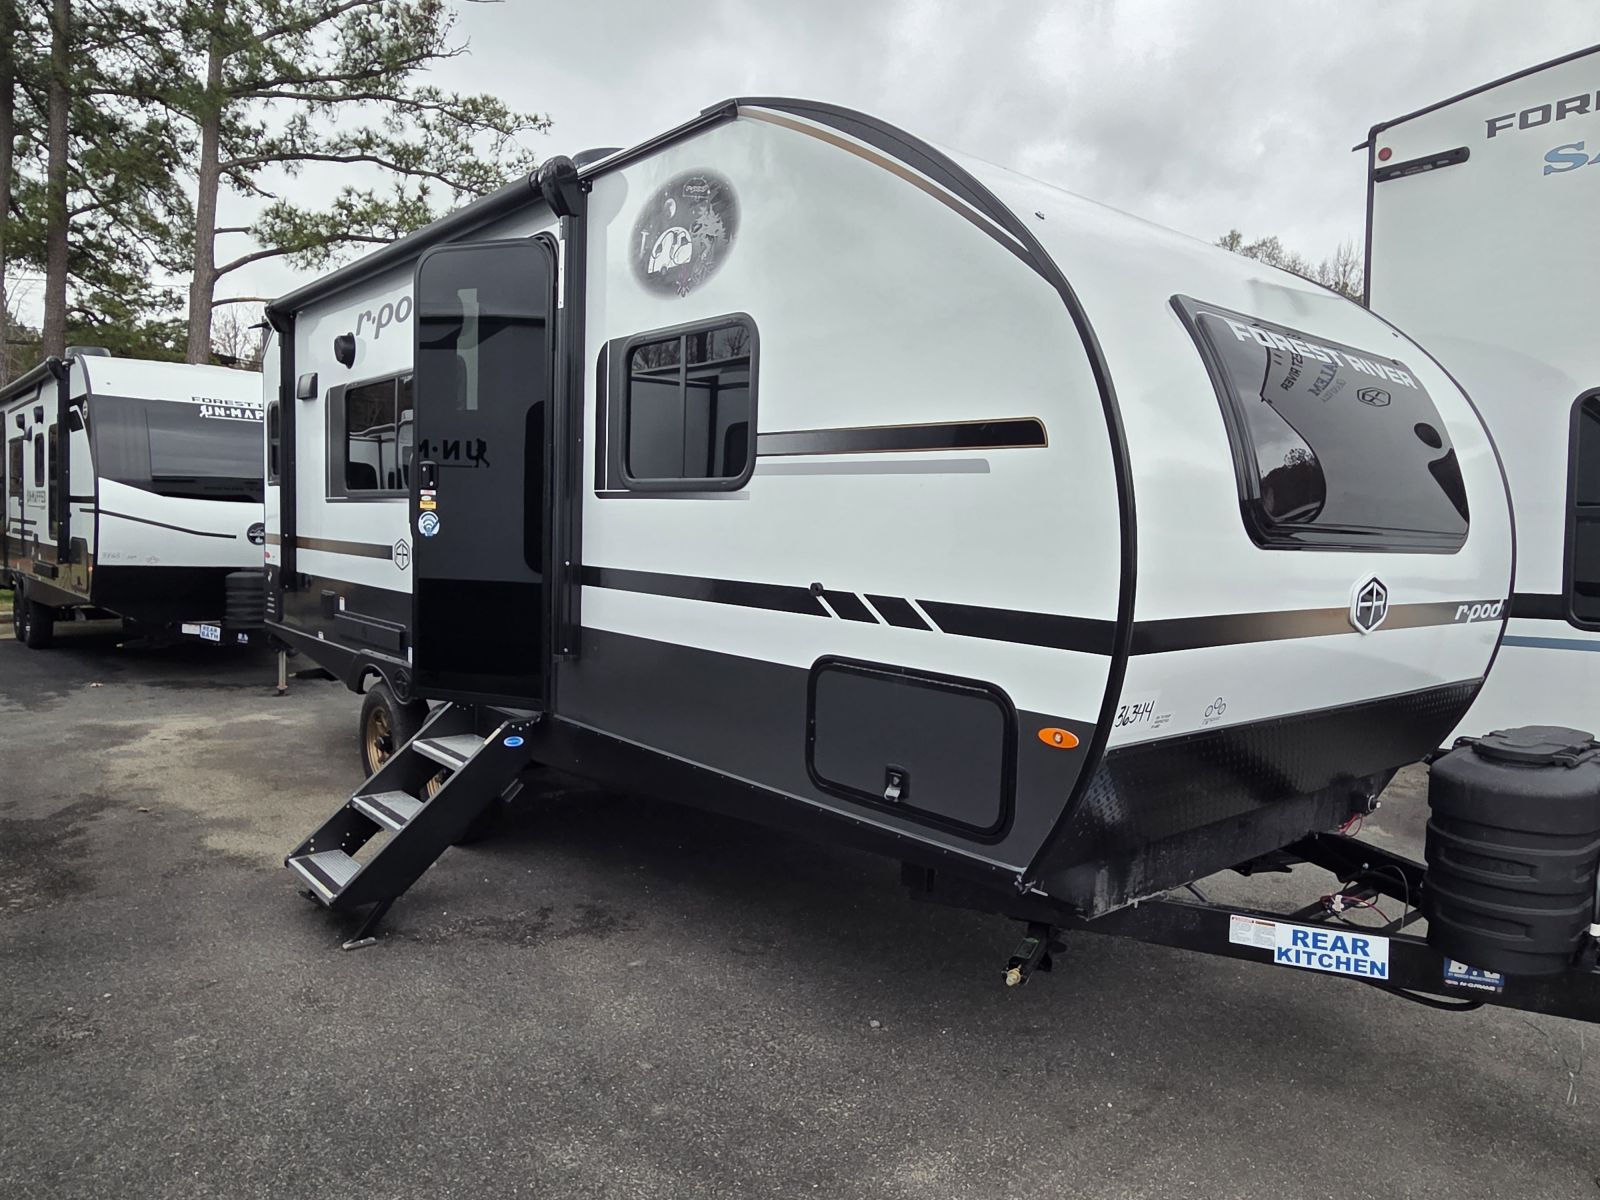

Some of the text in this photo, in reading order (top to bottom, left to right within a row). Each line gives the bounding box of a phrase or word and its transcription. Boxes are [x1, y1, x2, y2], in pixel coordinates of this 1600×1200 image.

[1485, 91, 1600, 138] FOR
[1224, 318, 1418, 390] FOREST RIVER
[1115, 700, 1155, 727] 36344
[1292, 929, 1370, 957] REAR
[1277, 946, 1386, 977] KITCHEN
